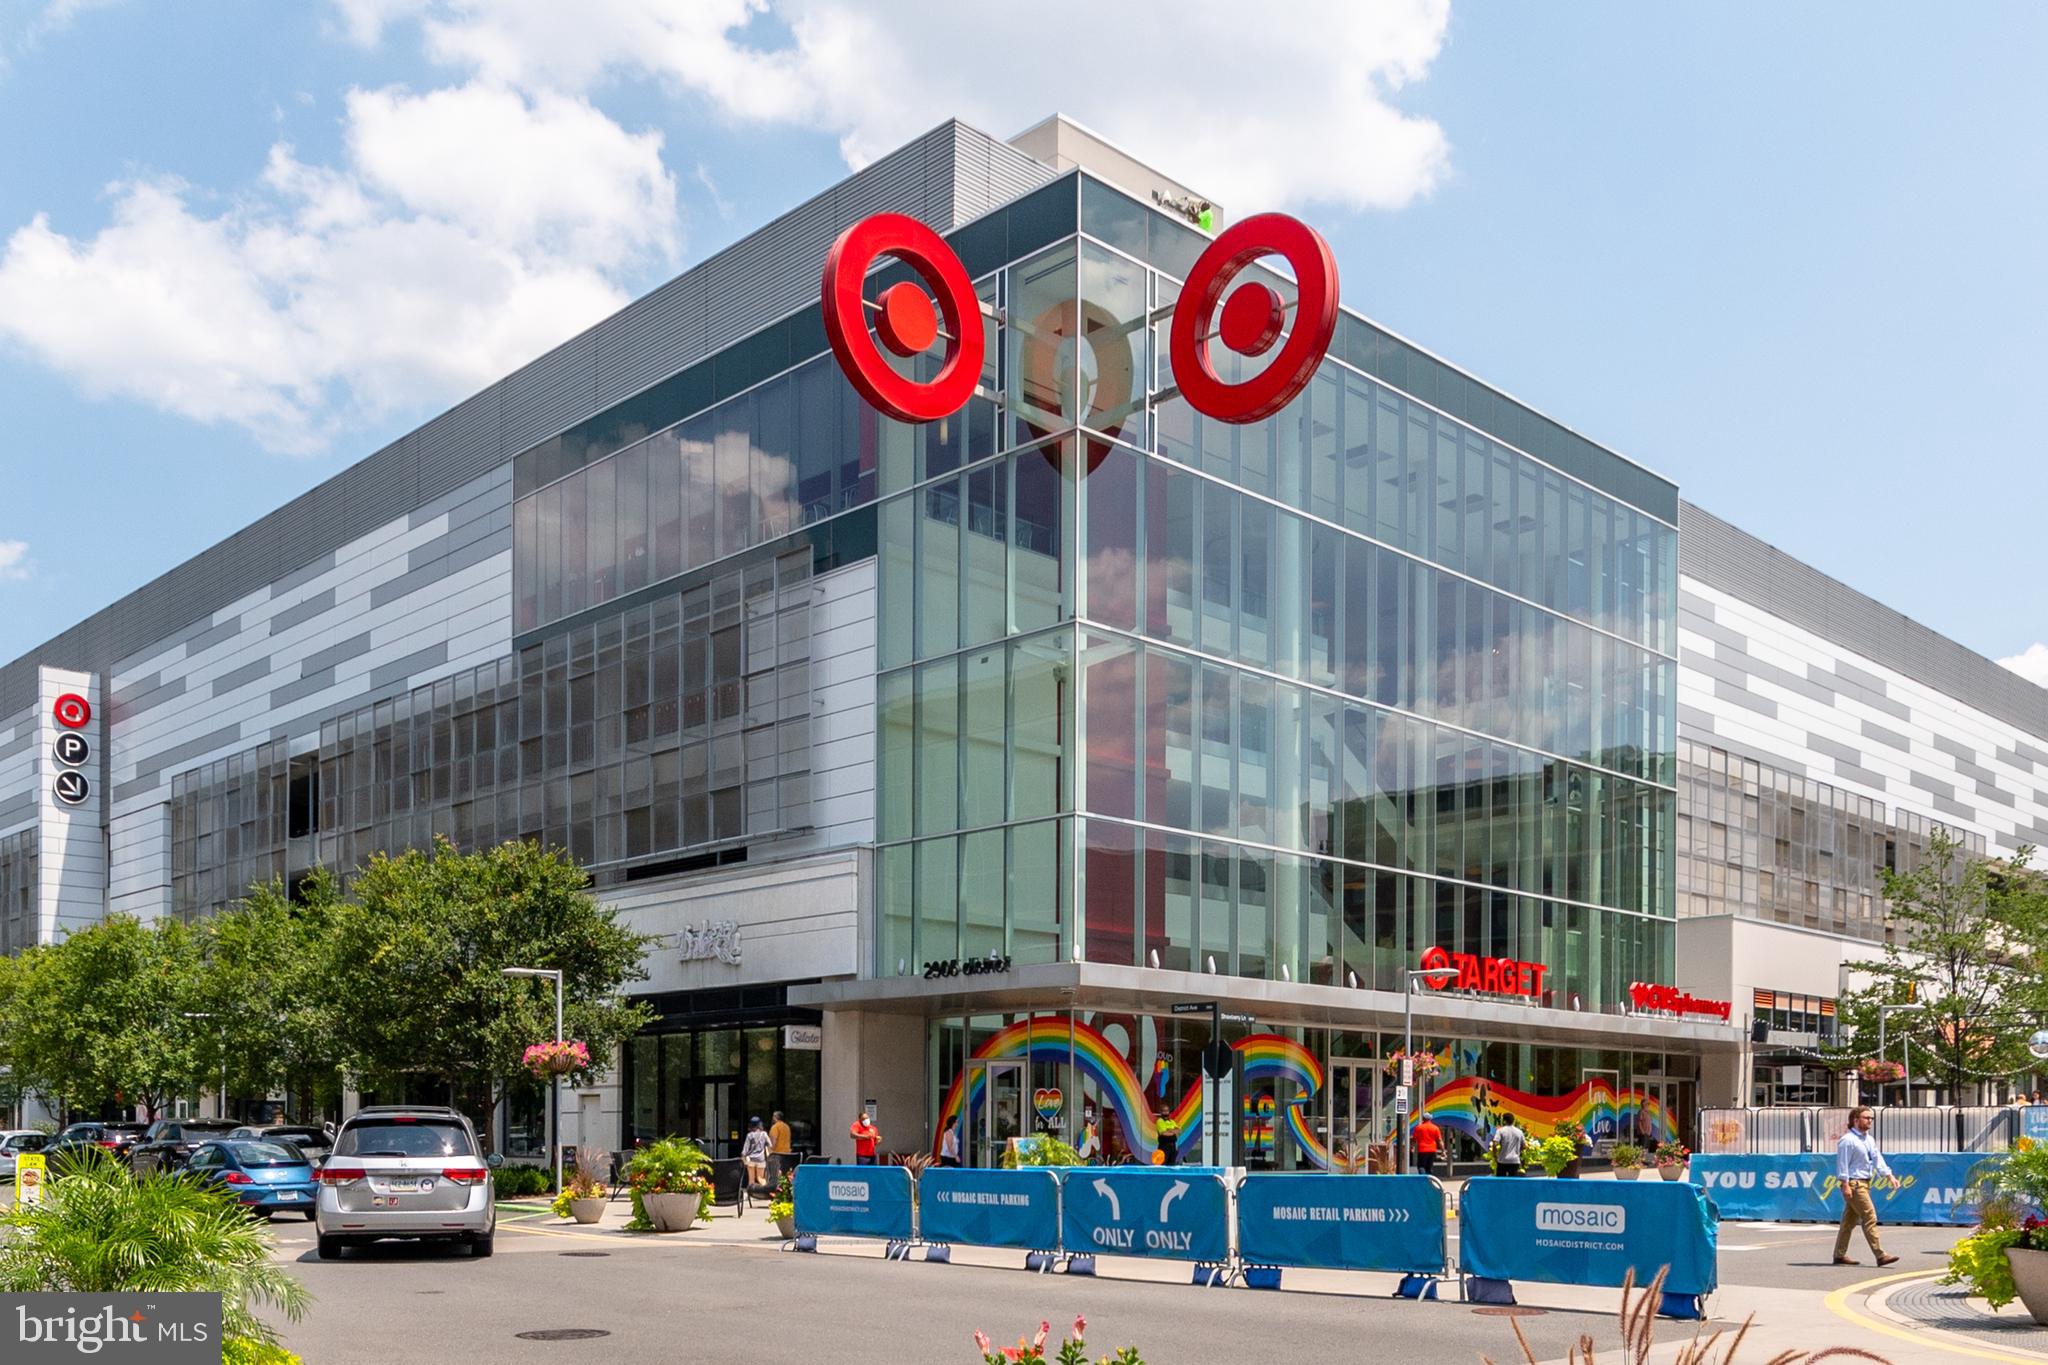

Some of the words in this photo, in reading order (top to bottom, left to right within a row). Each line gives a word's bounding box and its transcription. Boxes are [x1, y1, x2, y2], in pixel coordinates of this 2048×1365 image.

[65, 738, 81, 757] P
[1452, 951, 1547, 998] TARGET
[1038, 1094, 1060, 1110] Love
[1047, 1116, 1067, 1129] ALL
[1593, 1111, 1611, 1134] Love
[1702, 1171, 1756, 1189] YOU
[1764, 1171, 1818, 1189] SAY
[831, 1184, 866, 1198] mosaic
[951, 1191, 977, 1205] MOSAIC
[977, 1192, 1000, 1206] RETAIL
[1000, 1193, 1030, 1207] PARKING
[1272, 1206, 1308, 1221] MOSAIC
[1309, 1207, 1341, 1221] RETAIL
[1342, 1207, 1386, 1222] PARKING
[1542, 1208, 1619, 1228] mosaic
[1092, 1226, 1135, 1248] ONLY
[1146, 1230, 1193, 1251] ONLY
[1535, 1238, 1625, 1251] MOSAICDISTRICT.COM
